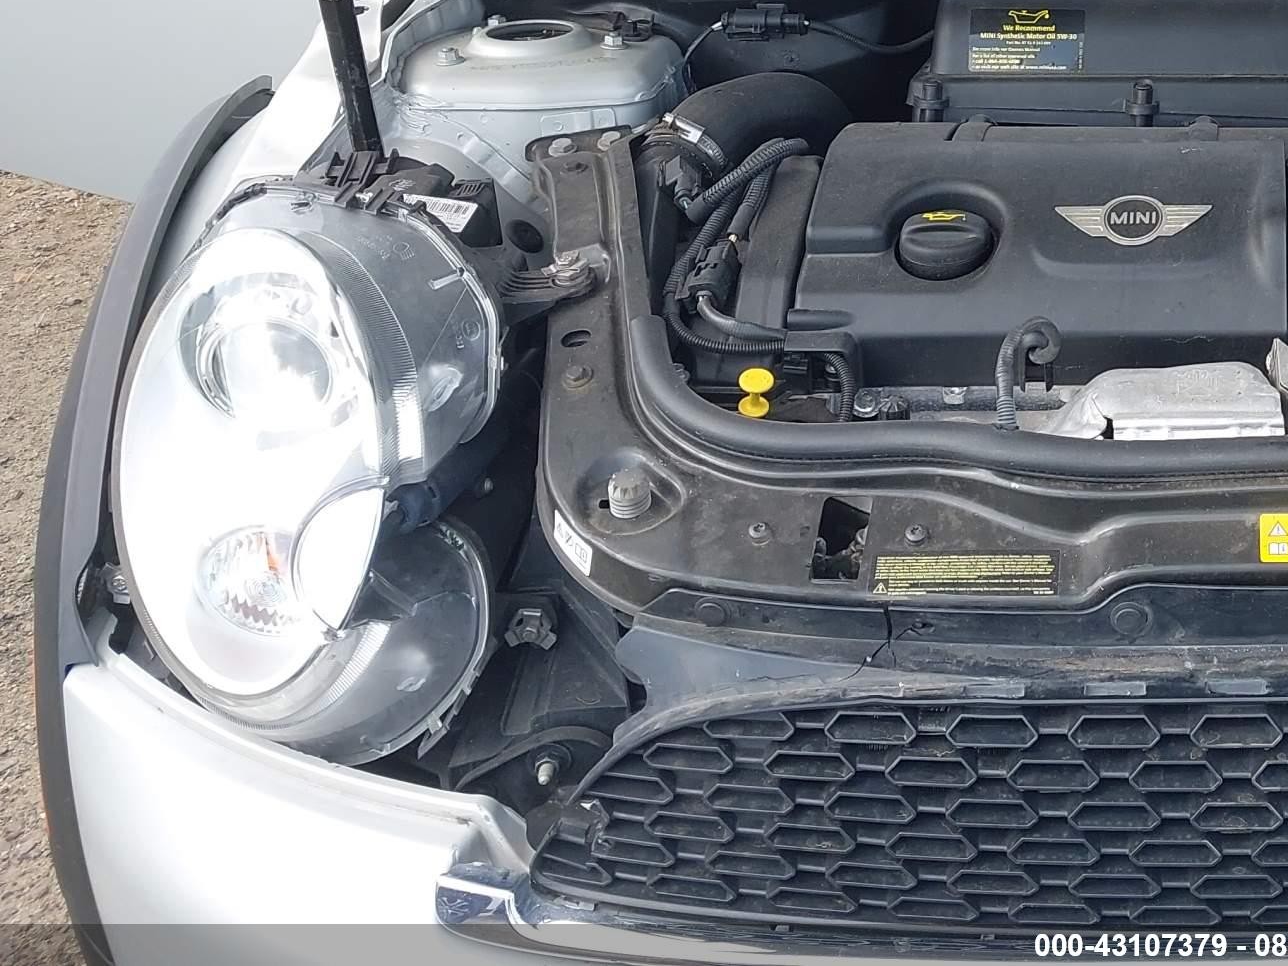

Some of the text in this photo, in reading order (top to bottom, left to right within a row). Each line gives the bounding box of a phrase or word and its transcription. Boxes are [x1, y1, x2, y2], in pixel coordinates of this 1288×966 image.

[1003, 24, 1056, 32] We Recommend
[980, 32, 996, 40] MINI
[997, 32, 1025, 41] Synthetic
[1026, 32, 1046, 40] Motor
[1109, 211, 1157, 225] MINI
